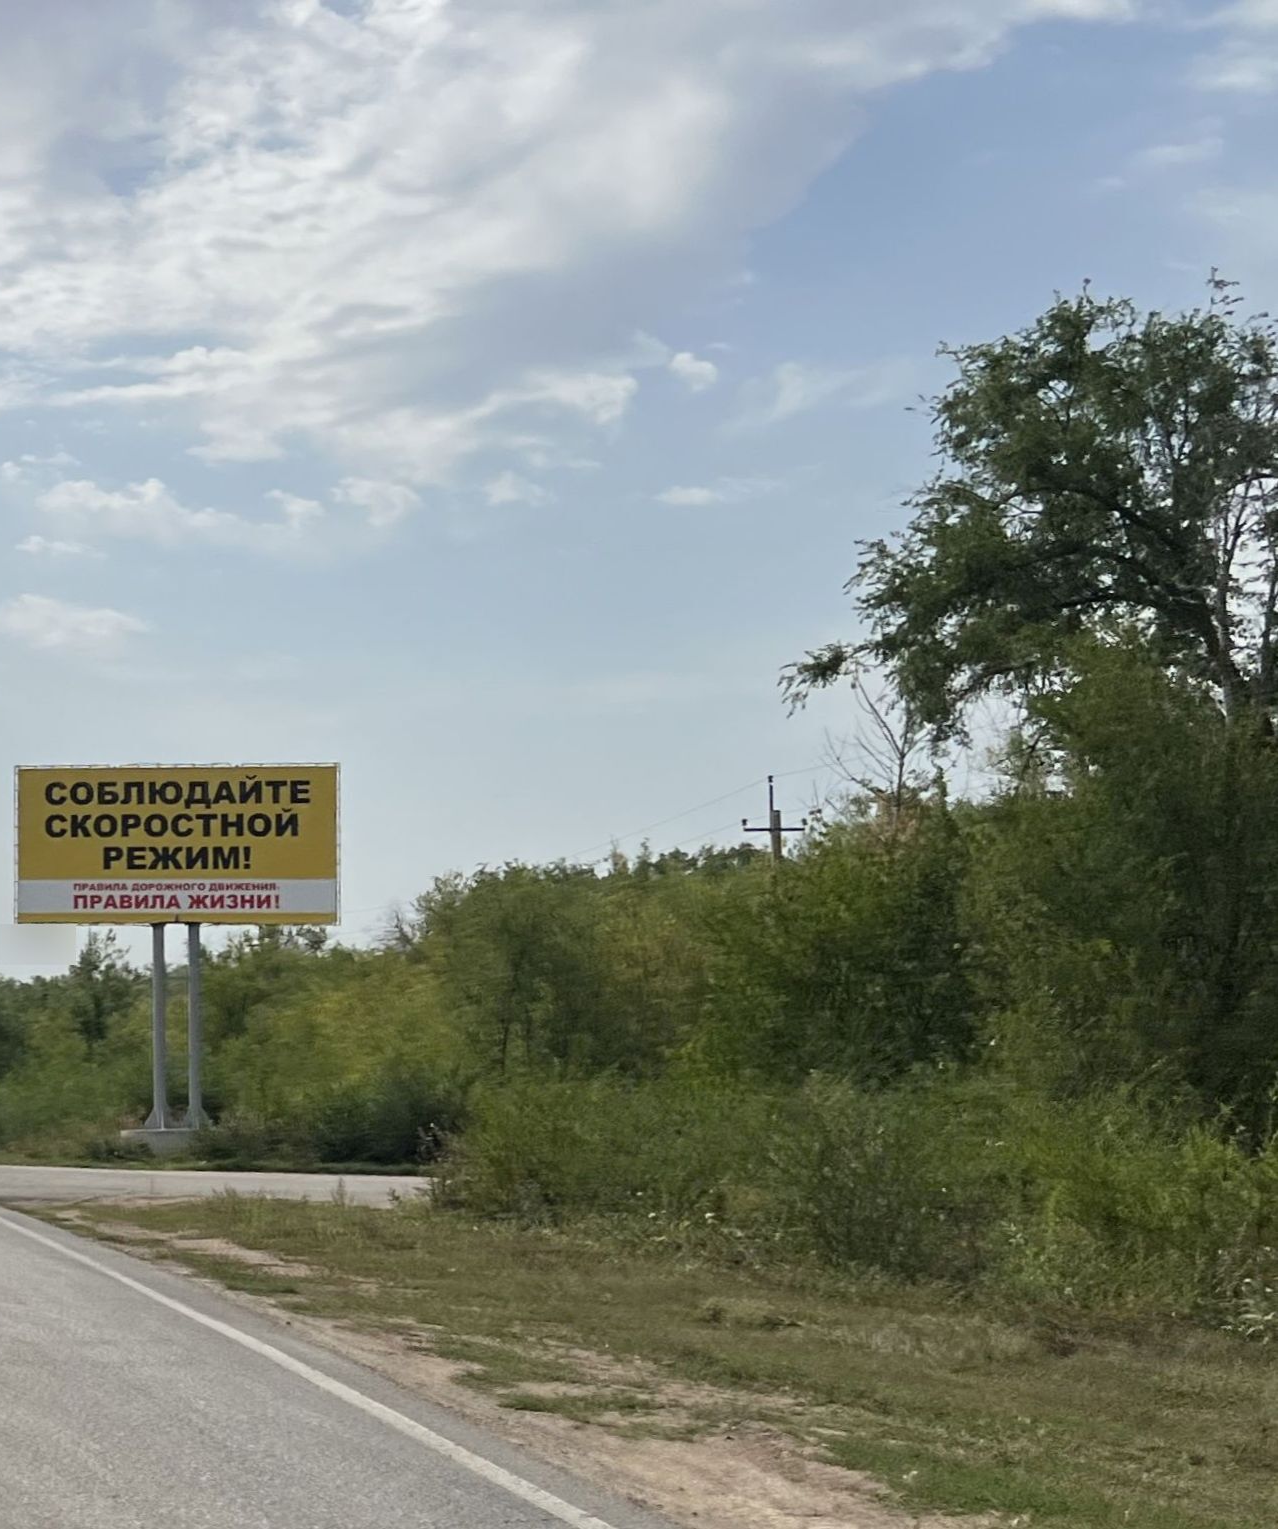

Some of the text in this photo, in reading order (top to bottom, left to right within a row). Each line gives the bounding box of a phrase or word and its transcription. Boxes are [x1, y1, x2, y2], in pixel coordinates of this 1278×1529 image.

[44, 775, 311, 809] СОБЛЮДАЙТЕ
[44, 808, 299, 838] СКОРОСТНОЙ
[102, 846, 252, 870] РЕЖИМ!
[73, 882, 128, 891] ПРАВИЛА
[131, 882, 206, 892] ДОРОЖНОГО
[72, 894, 280, 909] ПРАВИЛА ЖИЗНИ!
